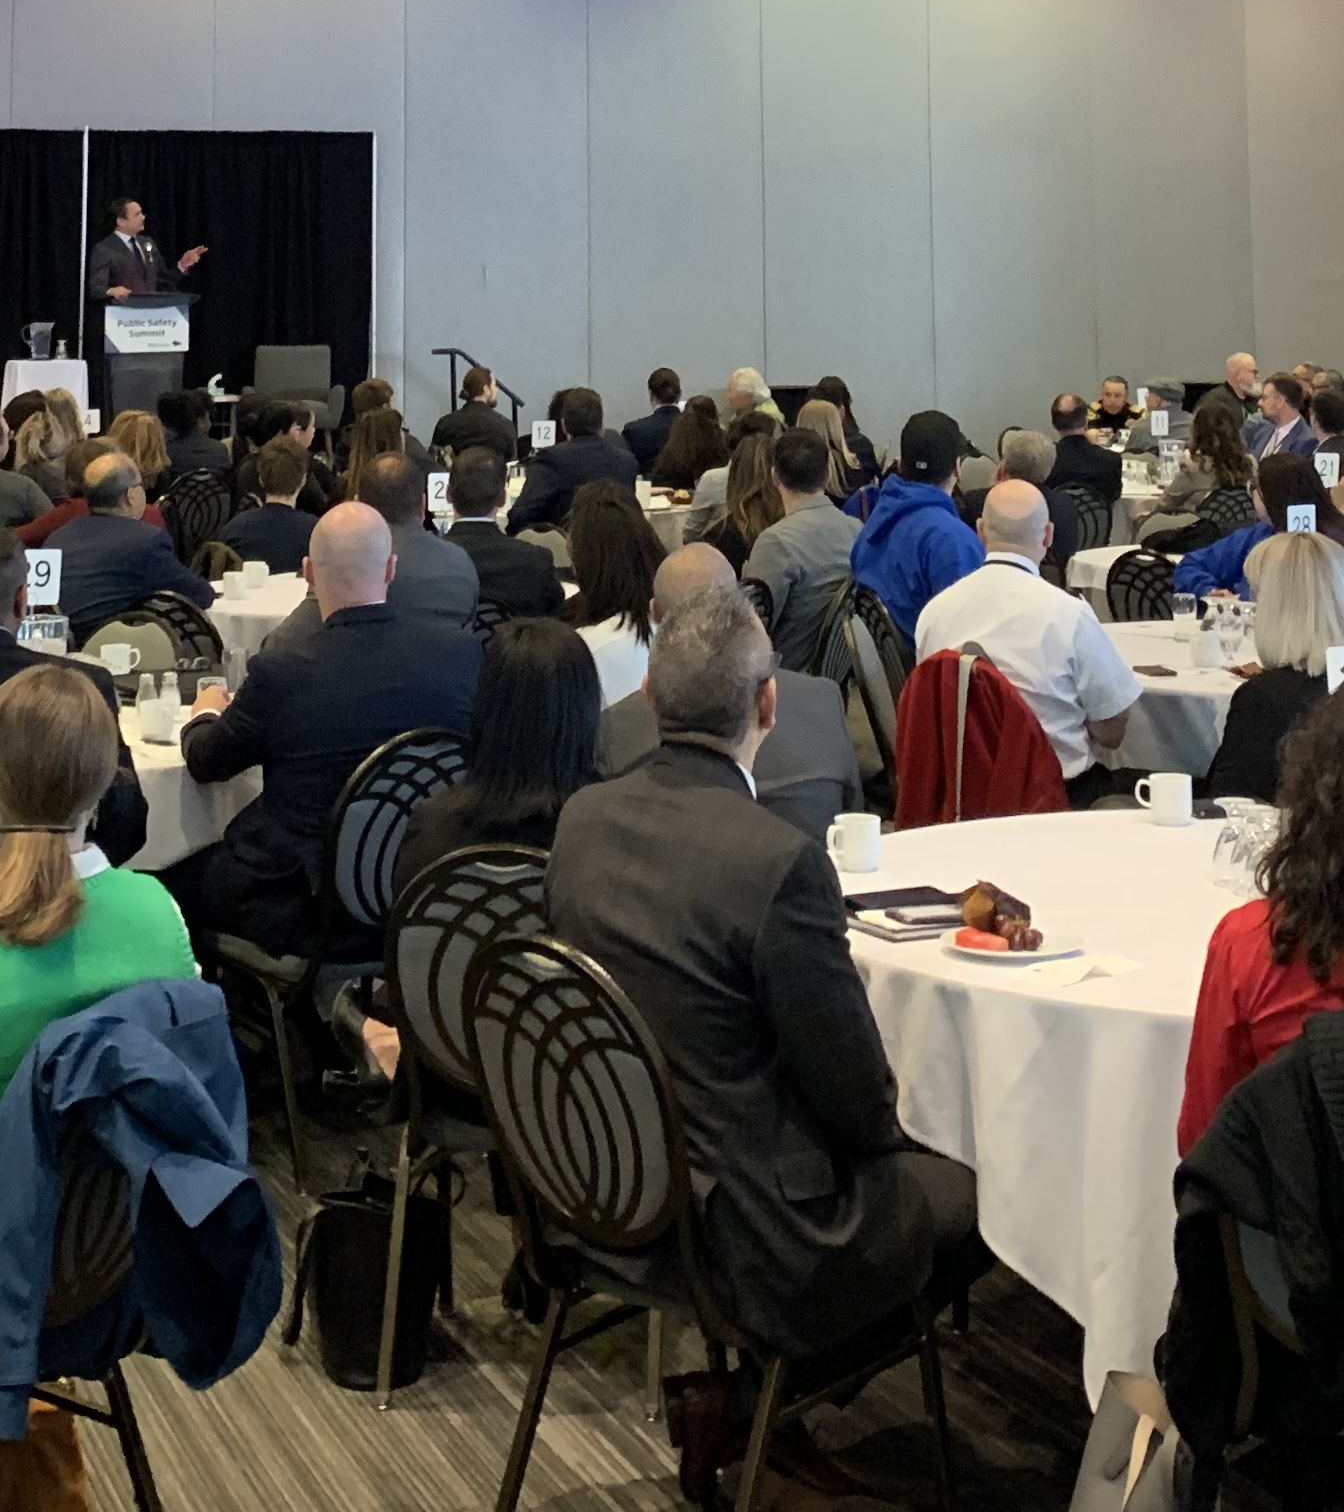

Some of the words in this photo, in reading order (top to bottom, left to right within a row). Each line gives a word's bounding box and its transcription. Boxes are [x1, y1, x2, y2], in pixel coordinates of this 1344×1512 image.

[118, 319, 145, 328] Public
[147, 318, 177, 328] Safety
[128, 329, 165, 338] Summit
[84, 414, 92, 426] 4
[537, 426, 551, 440] 12
[1320, 459, 1334, 477] 21
[433, 480, 446, 500] 2
[1292, 515, 1311, 533] 28
[27, 560, 51, 587] 9
